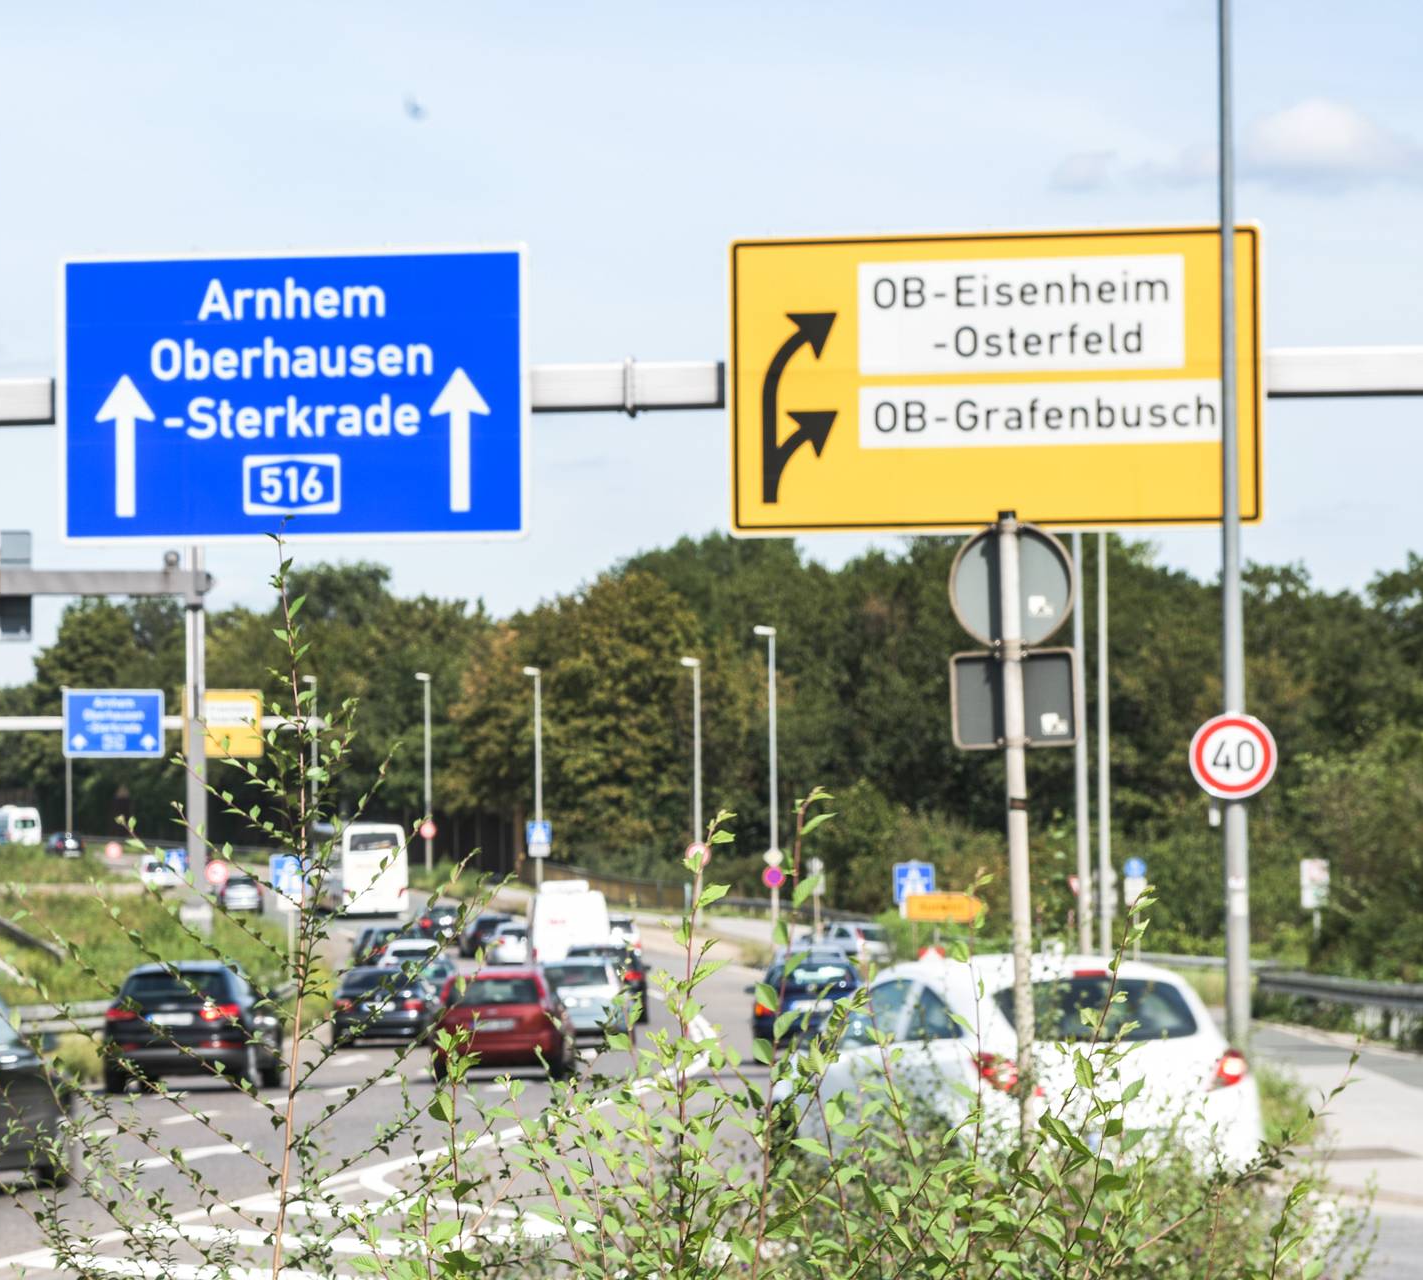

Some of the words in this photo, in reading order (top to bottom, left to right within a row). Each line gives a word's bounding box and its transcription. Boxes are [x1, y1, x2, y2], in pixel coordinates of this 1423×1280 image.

[198, 277, 386, 321] Arnhem
[873, 271, 1169, 309] OB-Eisenheim
[150, 336, 433, 381] Oberhausen
[934, 322, 1143, 358] -Osterfeld
[163, 393, 421, 440] -Sterkrade
[874, 395, 1217, 433] OB-Grafenbusch
[259, 465, 325, 504] 516
[1212, 740, 1255, 772] 40
